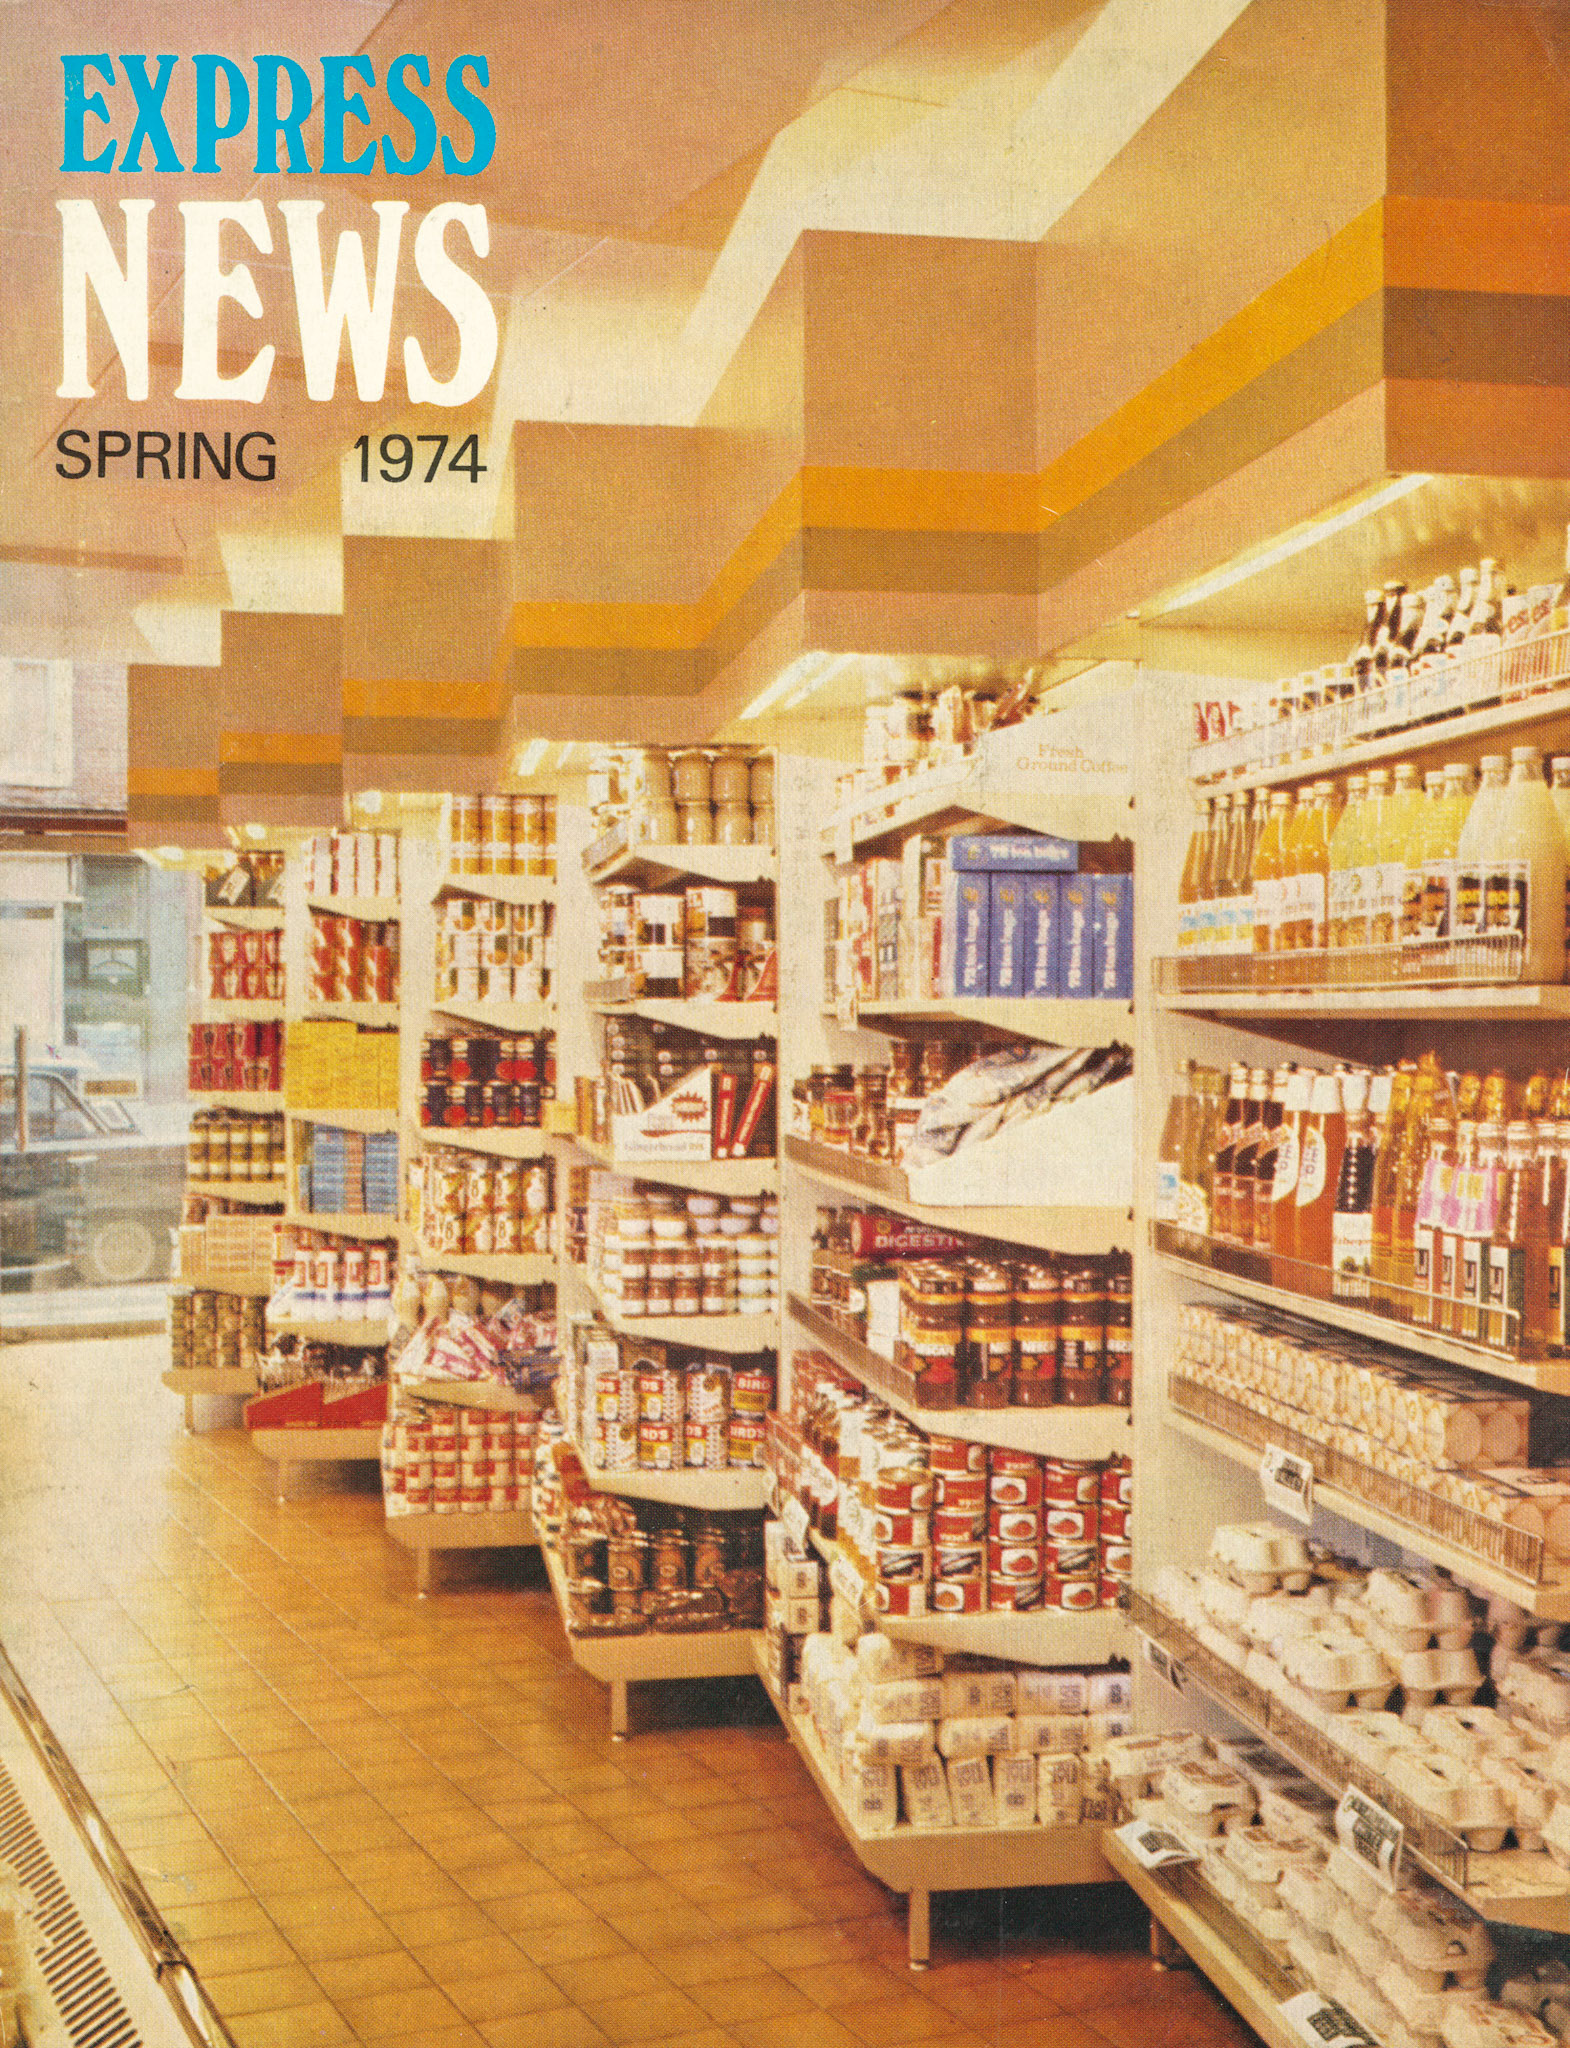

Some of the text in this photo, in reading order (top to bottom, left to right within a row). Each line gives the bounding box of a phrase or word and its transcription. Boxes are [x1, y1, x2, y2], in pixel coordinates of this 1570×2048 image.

[1038, 744, 1084, 758] Fresh
[1016, 757, 1129, 774] Ground Coffee
